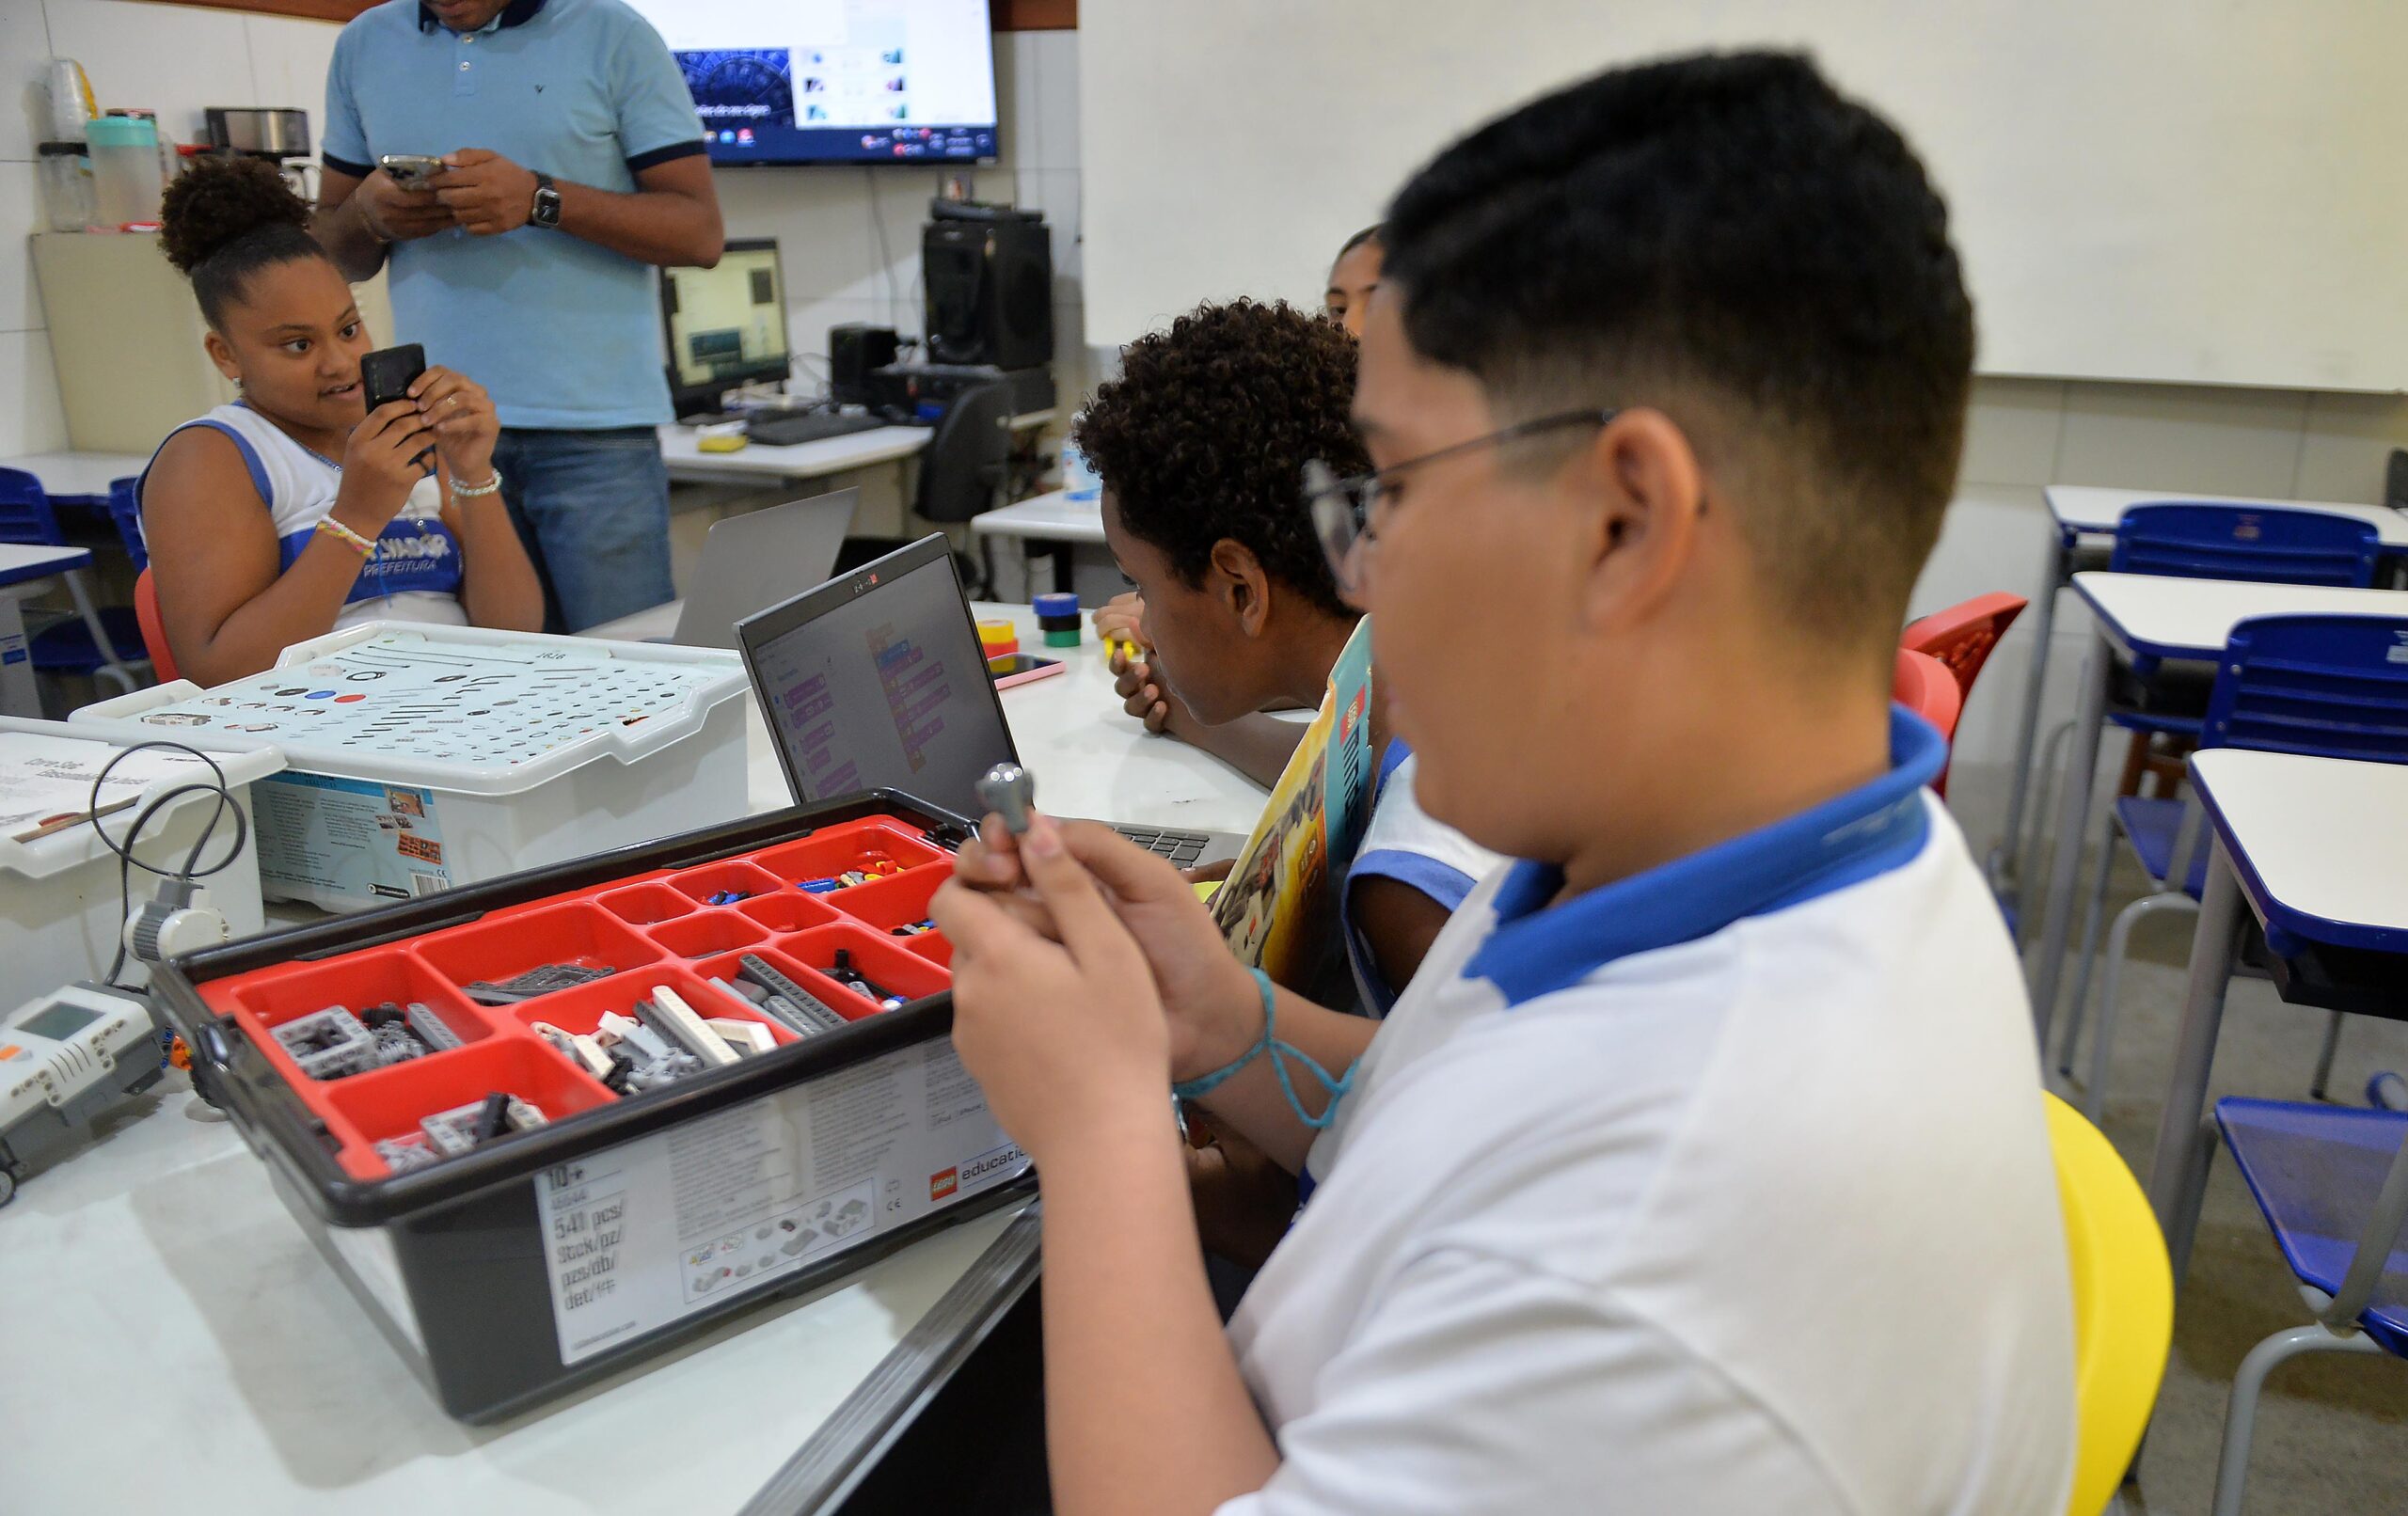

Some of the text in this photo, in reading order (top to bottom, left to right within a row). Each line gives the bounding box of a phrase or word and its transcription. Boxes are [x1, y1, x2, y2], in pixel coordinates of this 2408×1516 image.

[363, 561, 437, 578] PREFEITURA
[961, 1145, 1027, 1180] educati
[554, 1211, 585, 1240] 541
